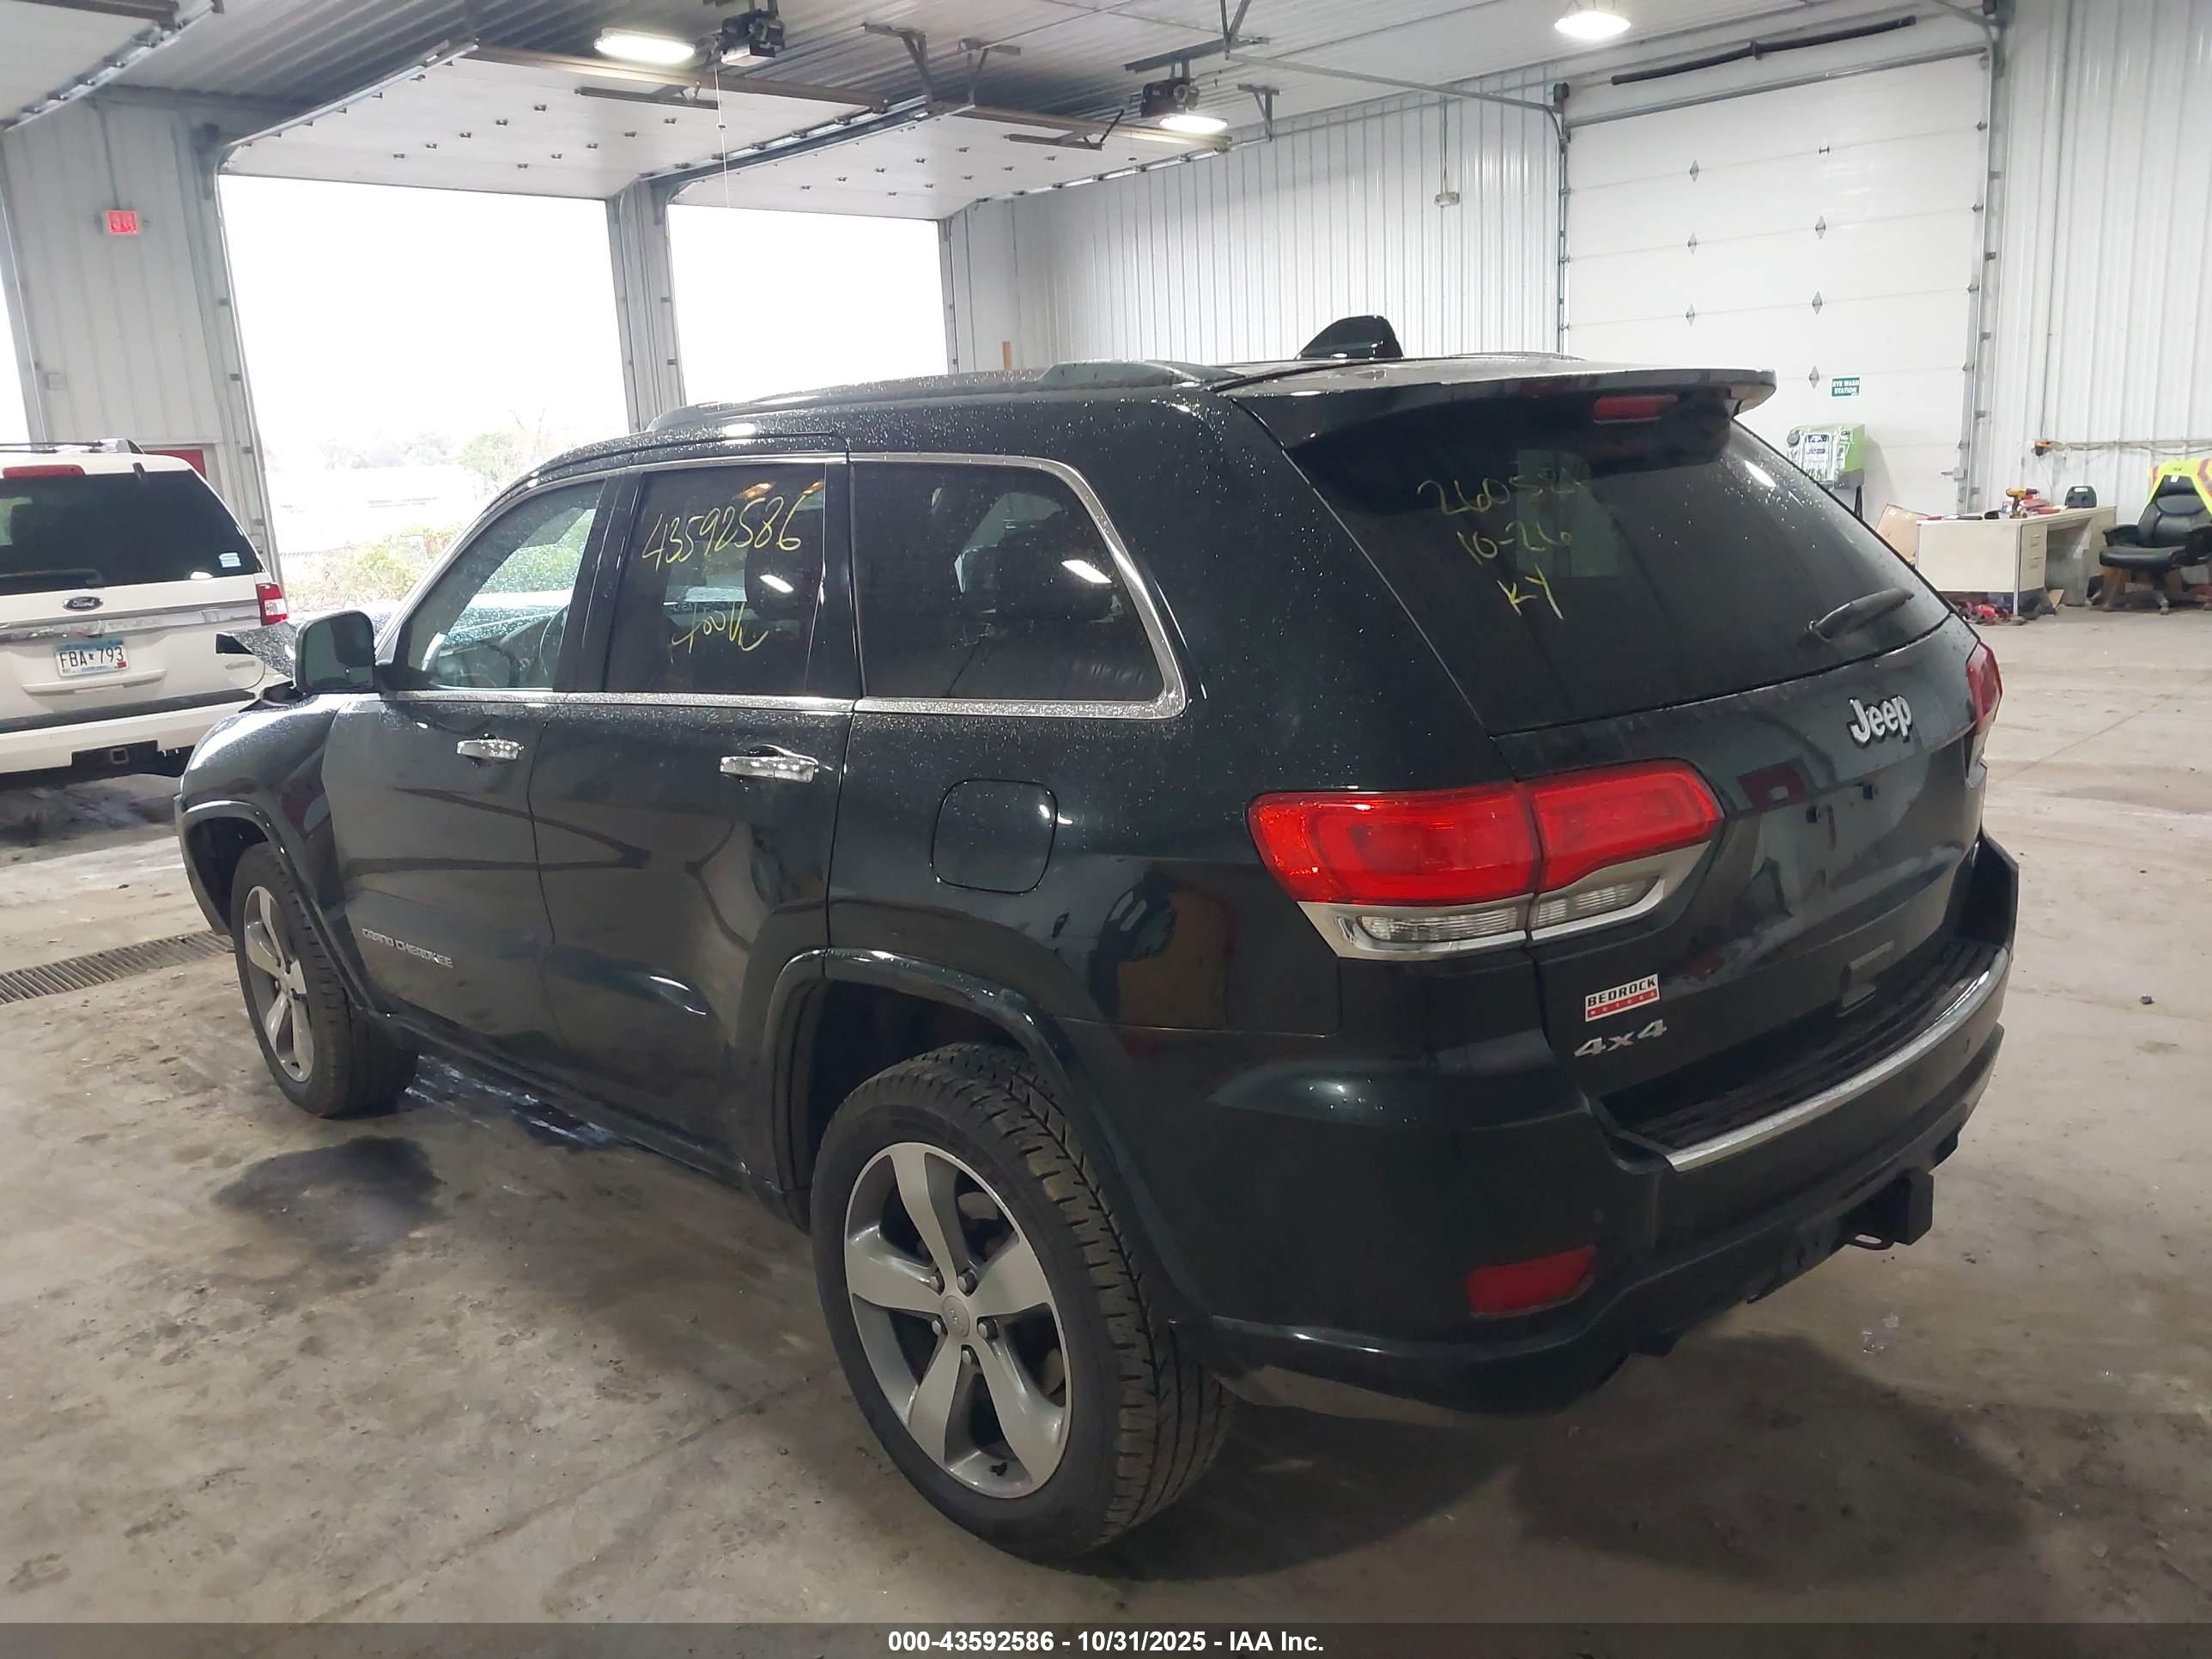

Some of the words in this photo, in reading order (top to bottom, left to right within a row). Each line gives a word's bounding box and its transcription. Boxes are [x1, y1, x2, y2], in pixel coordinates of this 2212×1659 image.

[642, 495, 802, 572] 43592586
[1497, 563, 1564, 619] KY
[59, 649, 88, 669] FBA
[96, 646, 125, 665] 793
[1850, 695, 1912, 744] Jeep
[1587, 976, 1656, 1007] BEDROCK
[1574, 1019, 1668, 1057] 4x4
